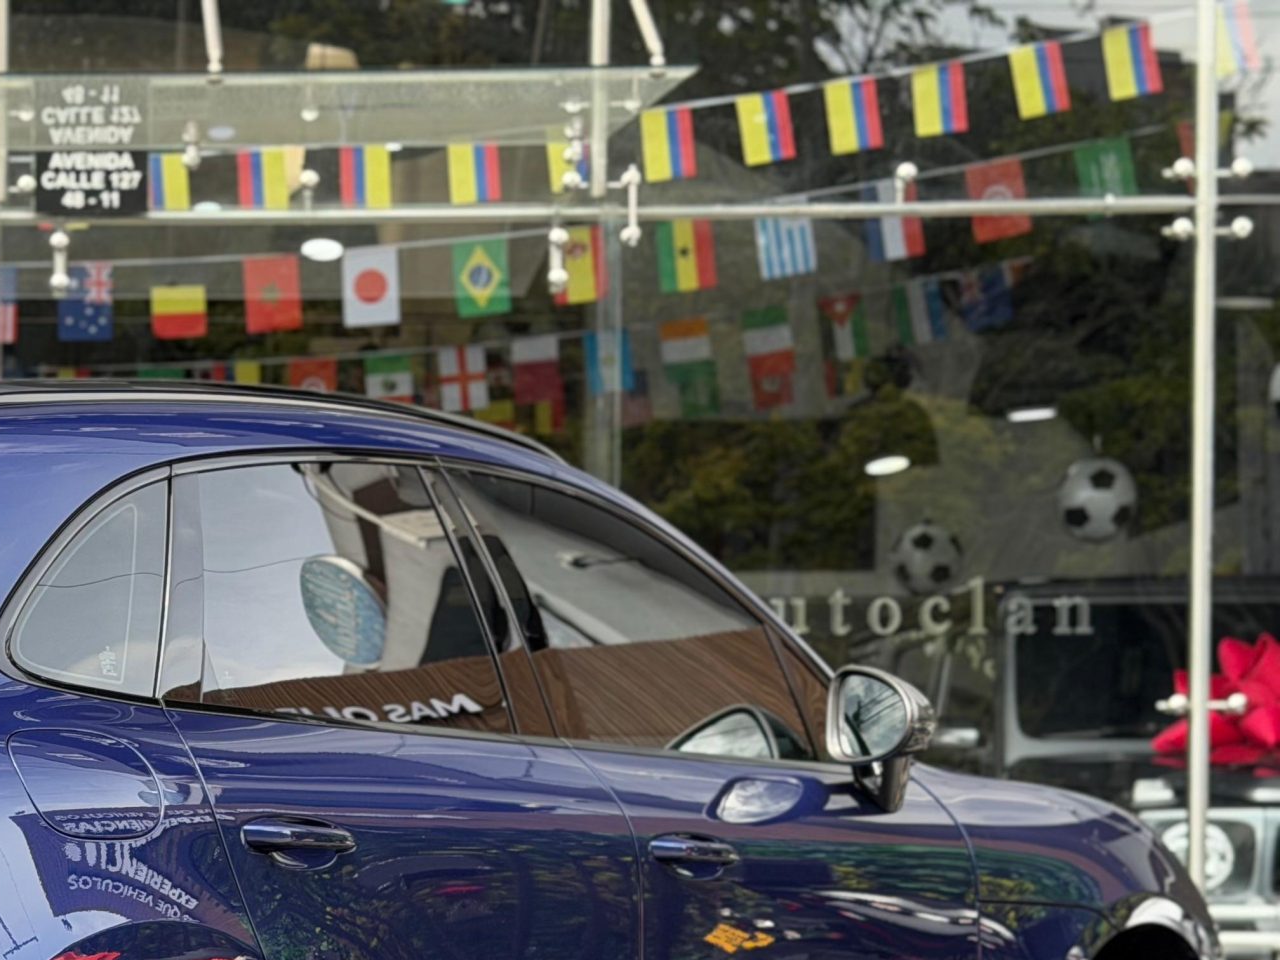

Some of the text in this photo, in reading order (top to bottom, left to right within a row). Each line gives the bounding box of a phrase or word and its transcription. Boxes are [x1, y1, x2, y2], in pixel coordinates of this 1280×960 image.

[48, 152, 135, 170] AVENIDA
[40, 171, 143, 190] CALLE 127
[100, 191, 121, 209] 11
